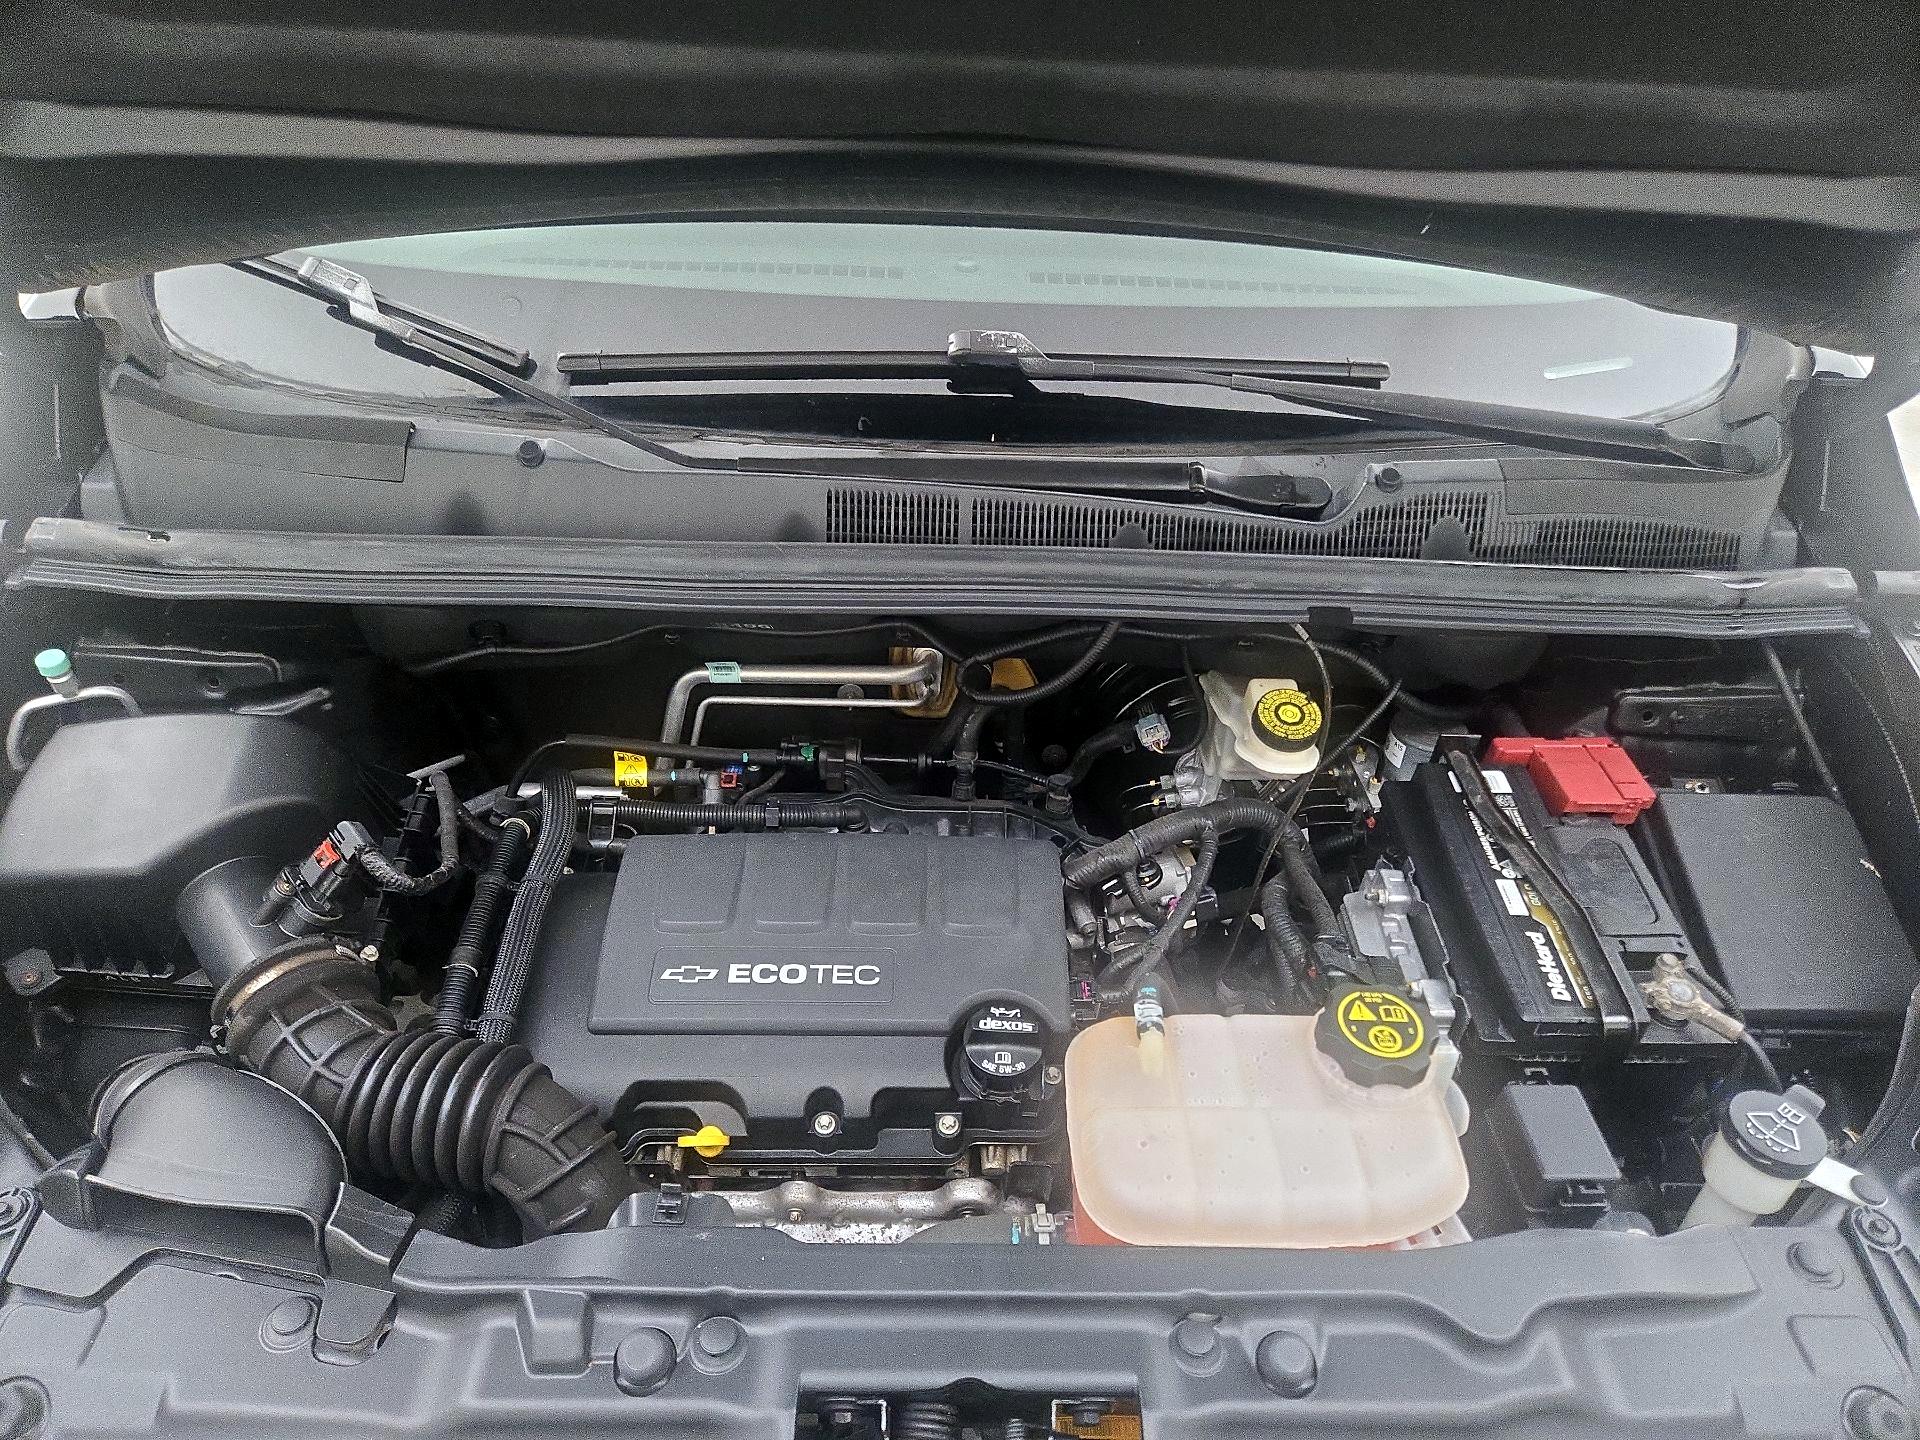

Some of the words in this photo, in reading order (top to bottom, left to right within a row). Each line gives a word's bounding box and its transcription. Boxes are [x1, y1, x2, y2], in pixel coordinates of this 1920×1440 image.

[727, 963, 881, 985] ECOTEC
[1524, 931, 1572, 1001] DieHard
[979, 1017, 1035, 1032] dexos
[981, 1060, 997, 1072] SAE
[1000, 1062, 1026, 1074] 5W-30
